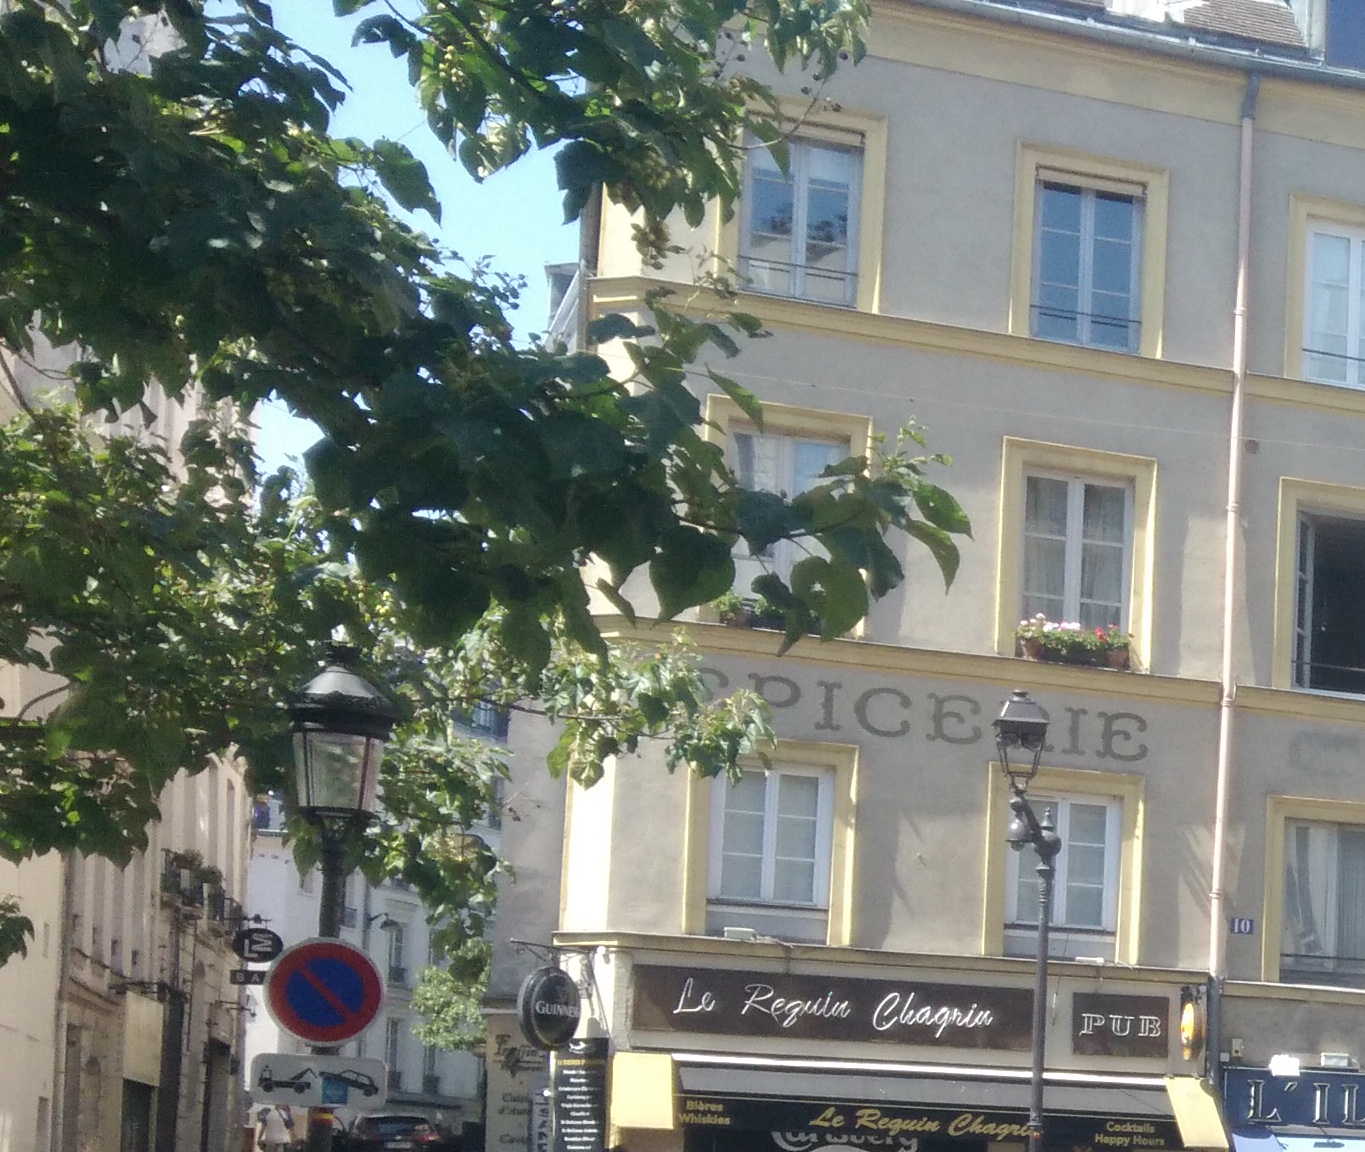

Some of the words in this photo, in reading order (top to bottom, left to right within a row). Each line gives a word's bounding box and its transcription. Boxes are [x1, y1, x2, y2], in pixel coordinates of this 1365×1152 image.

[694, 667, 1148, 762] PICEIE
[1234, 918, 1250, 933] 10
[535, 1001, 580, 1018] GUINNE
[673, 977, 716, 1015] Le
[741, 983, 850, 1029] Requin
[872, 991, 993, 1039] Chagrin
[1078, 1012, 1163, 1038] PUB
[809, 1107, 845, 1128] Le
[855, 1109, 941, 1135] Requin
[948, 1113, 1043, 1140] Chagri
[1106, 1122, 1156, 1134] Cocktails
[1095, 1133, 1130, 1147] Happy
[1133, 1135, 1165, 1147] Hours
